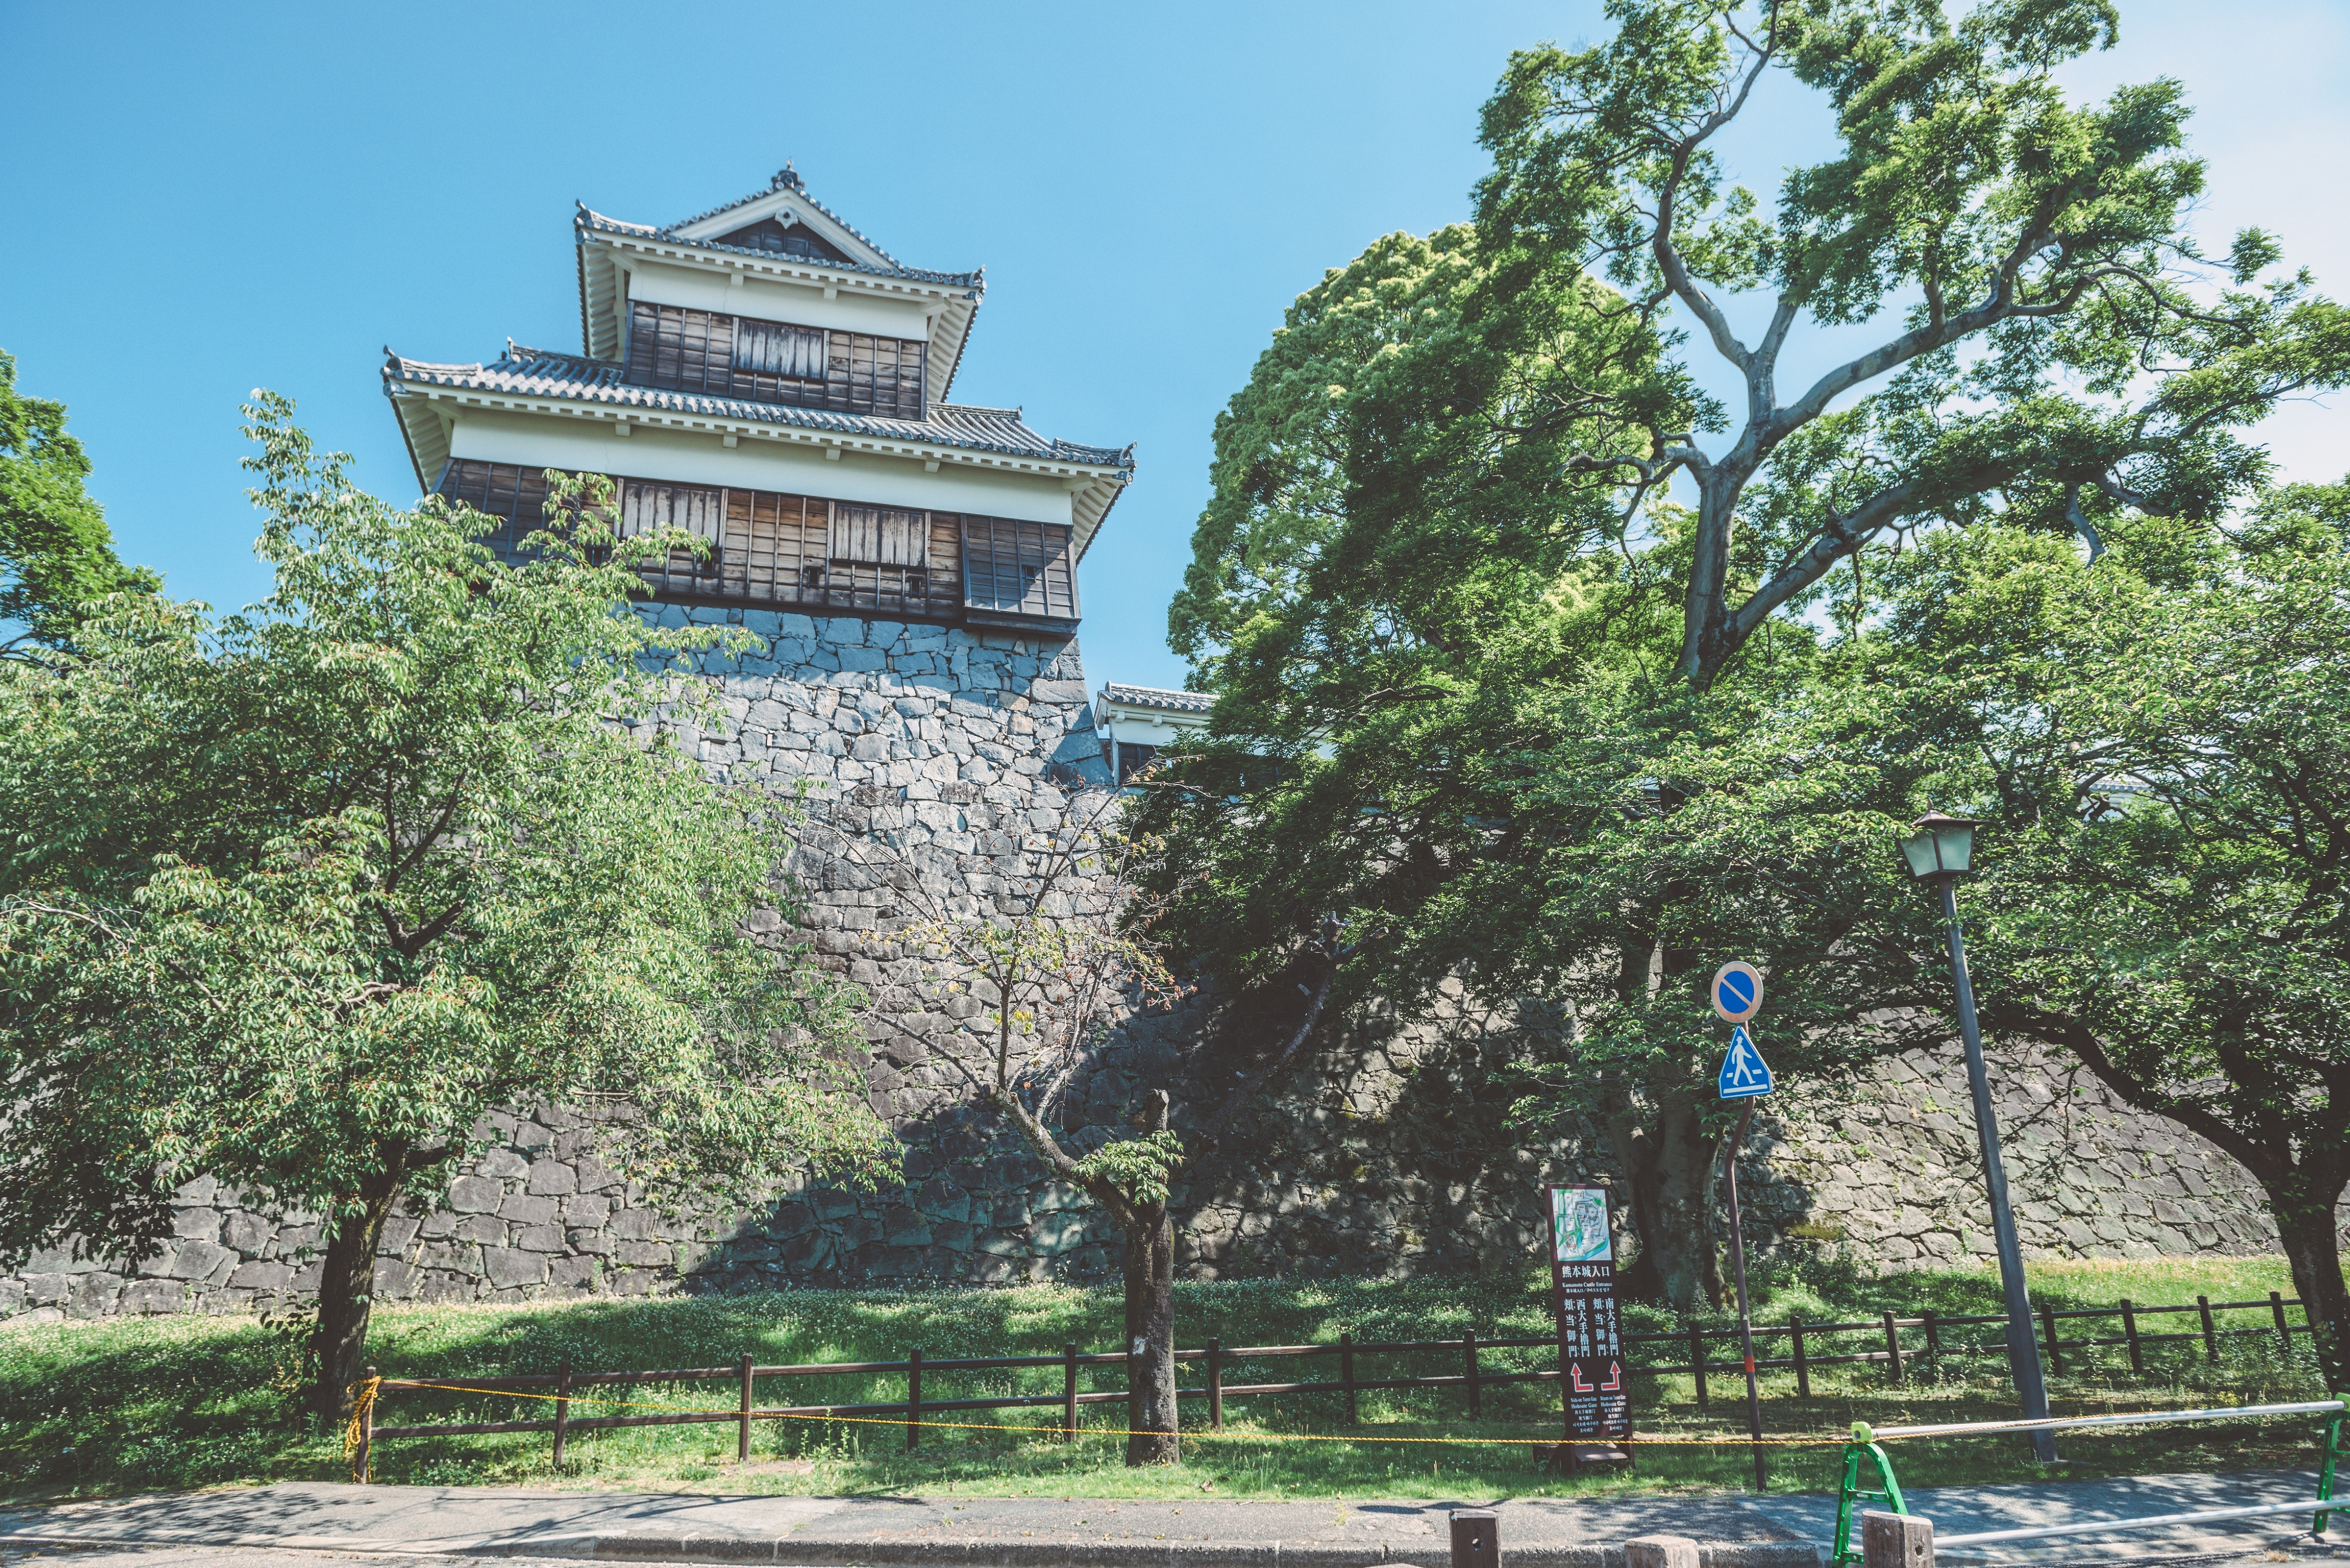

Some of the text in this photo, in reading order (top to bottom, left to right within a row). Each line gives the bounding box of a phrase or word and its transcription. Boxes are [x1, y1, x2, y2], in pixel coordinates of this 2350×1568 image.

[1562, 1265, 1610, 1278] 熊本城入口
[1576, 1298, 1590, 1357] 西大手櫓門
[1605, 1297, 1619, 1356] 南大手櫓門
